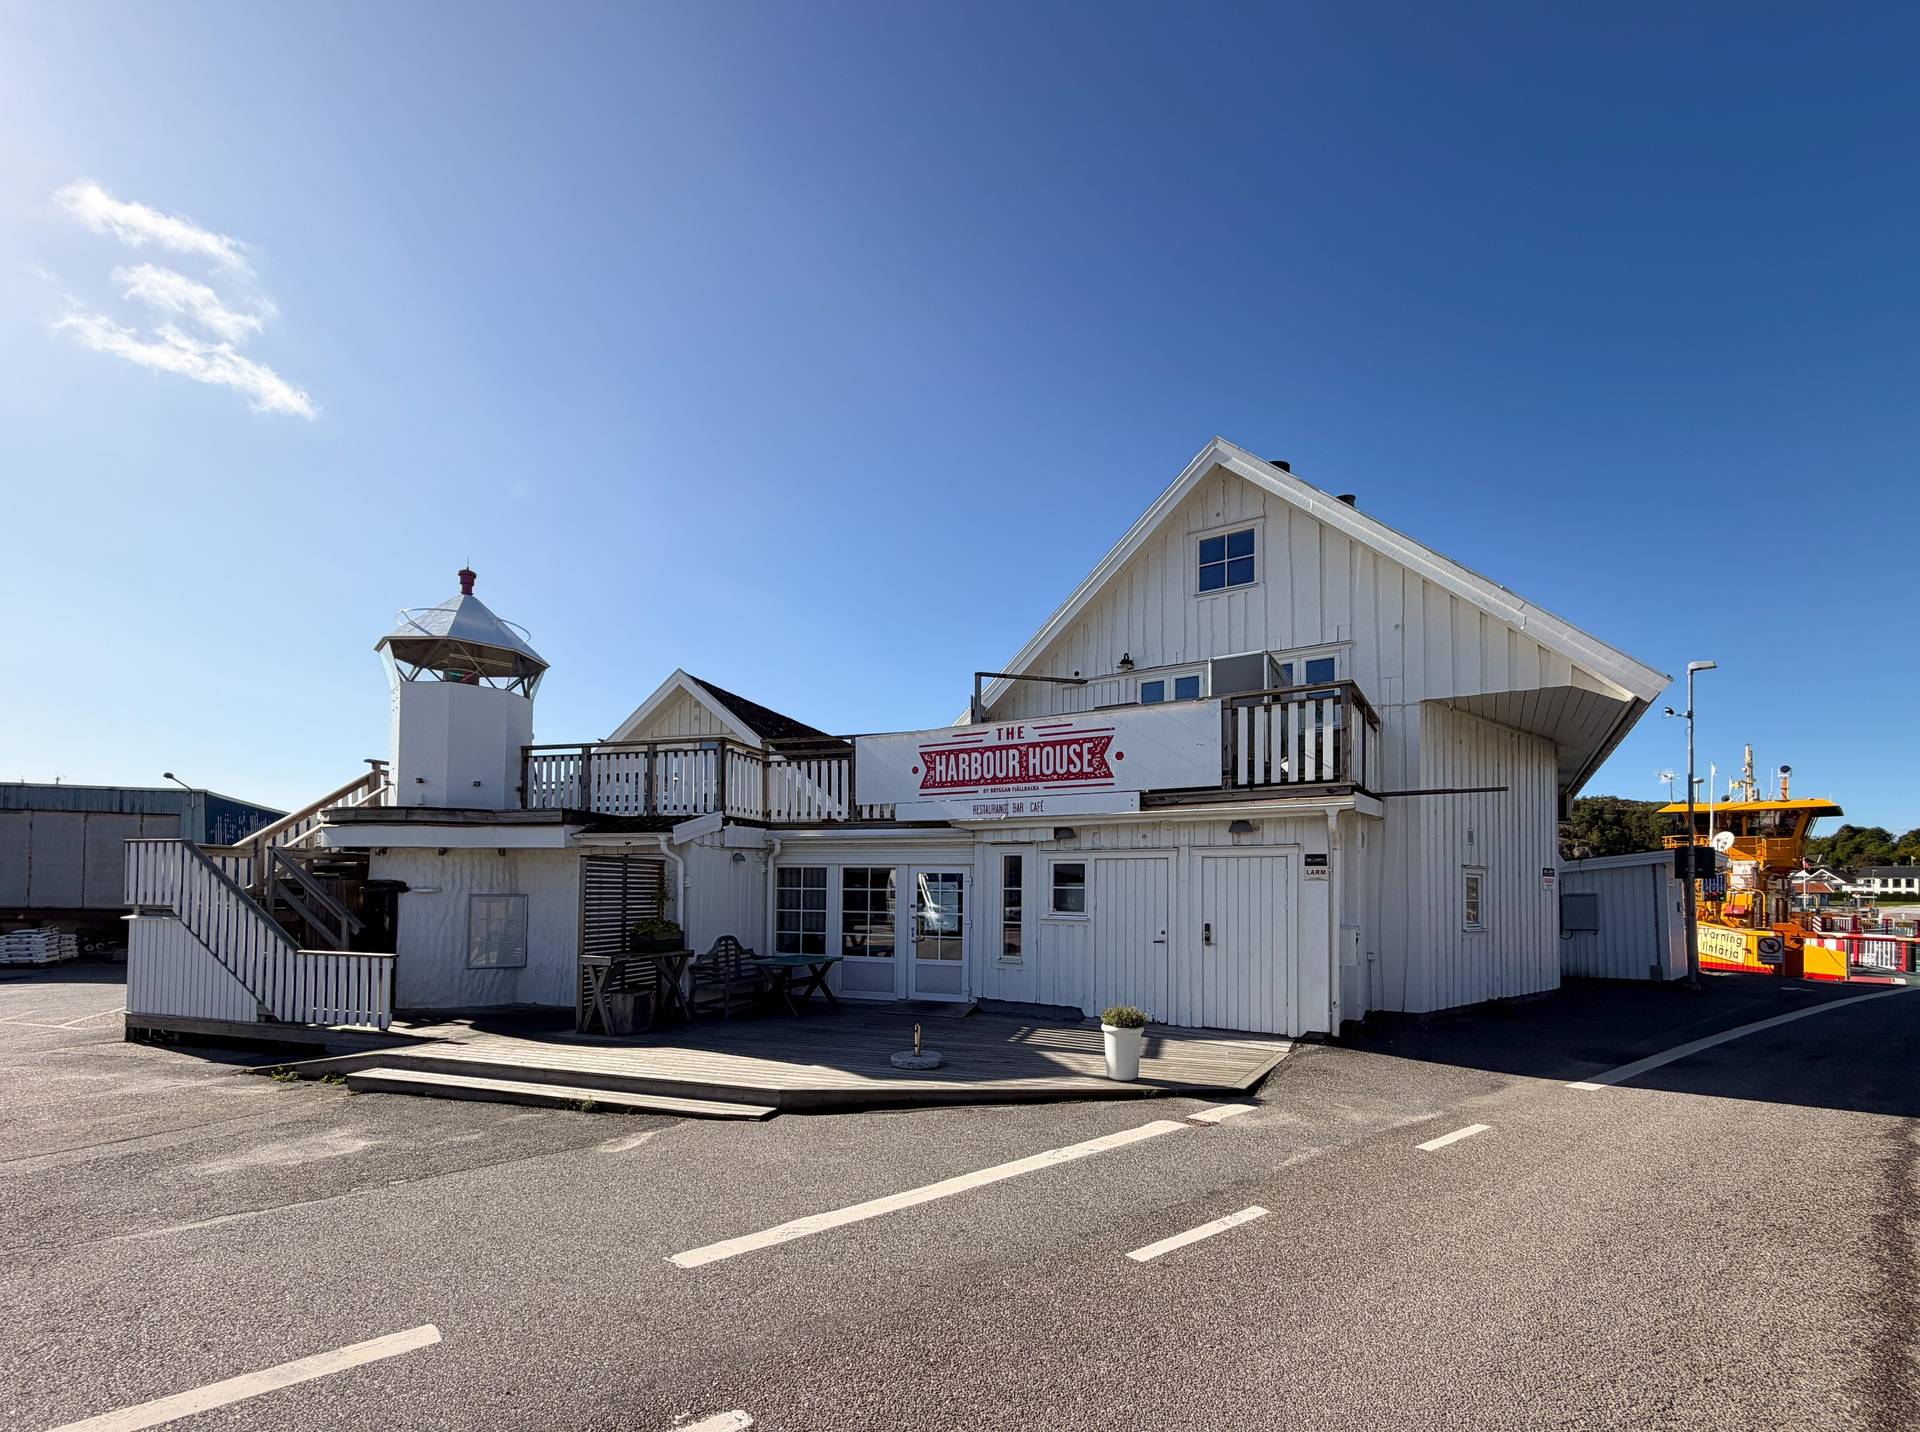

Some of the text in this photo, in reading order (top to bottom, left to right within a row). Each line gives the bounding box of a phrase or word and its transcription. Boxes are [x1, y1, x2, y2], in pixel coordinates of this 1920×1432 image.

[996, 726, 1025, 741] THE
[935, 742, 1094, 782] HARBOUR HOUSE
[1012, 802, 1024, 813] BAR
[1029, 799, 1044, 813] CAFÉ
[1703, 928, 1742, 948] Varning
[1702, 941, 1739, 959] linfärja
